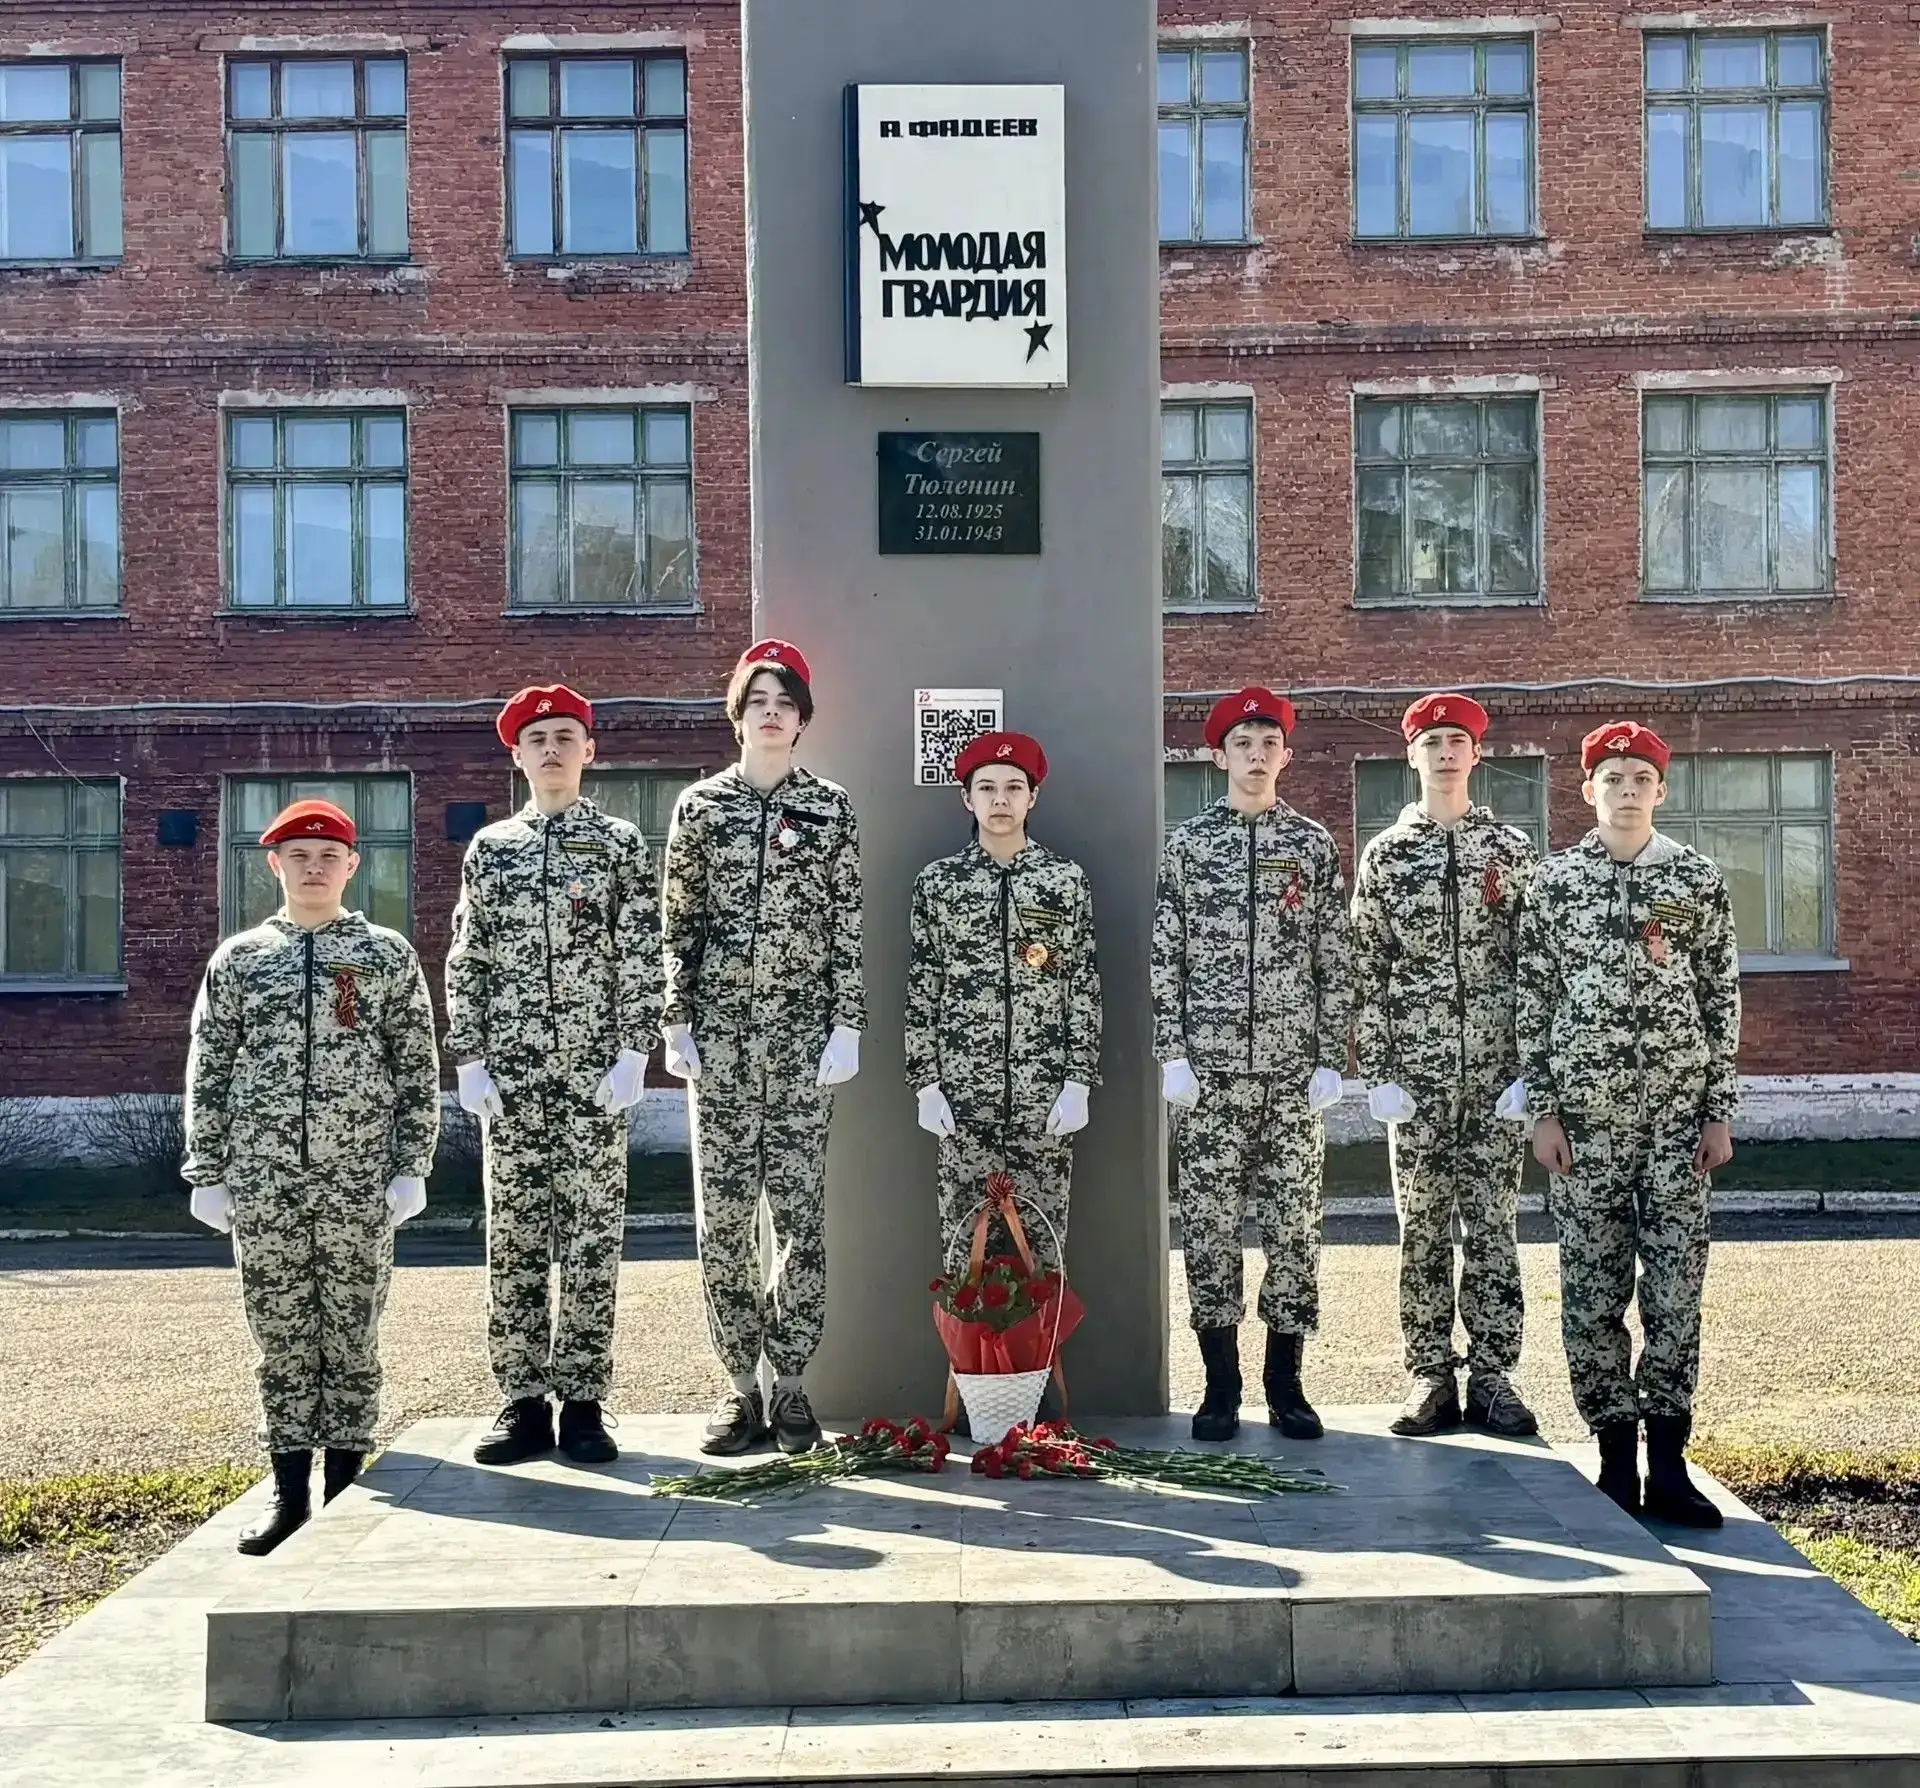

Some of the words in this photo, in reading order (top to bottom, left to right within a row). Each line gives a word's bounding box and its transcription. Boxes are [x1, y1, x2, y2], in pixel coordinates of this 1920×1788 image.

[909, 119, 1038, 137] ФАДЕЕВ
[879, 231, 1046, 274] МОЛОДАЯ
[881, 278, 1046, 322] ГВАРДИЯ
[916, 441, 1003, 468] Сергей
[905, 473, 1016, 495] Тюленин
[916, 504, 1003, 519] 12.08.1925
[915, 526, 1003, 541] 31.01.1943
